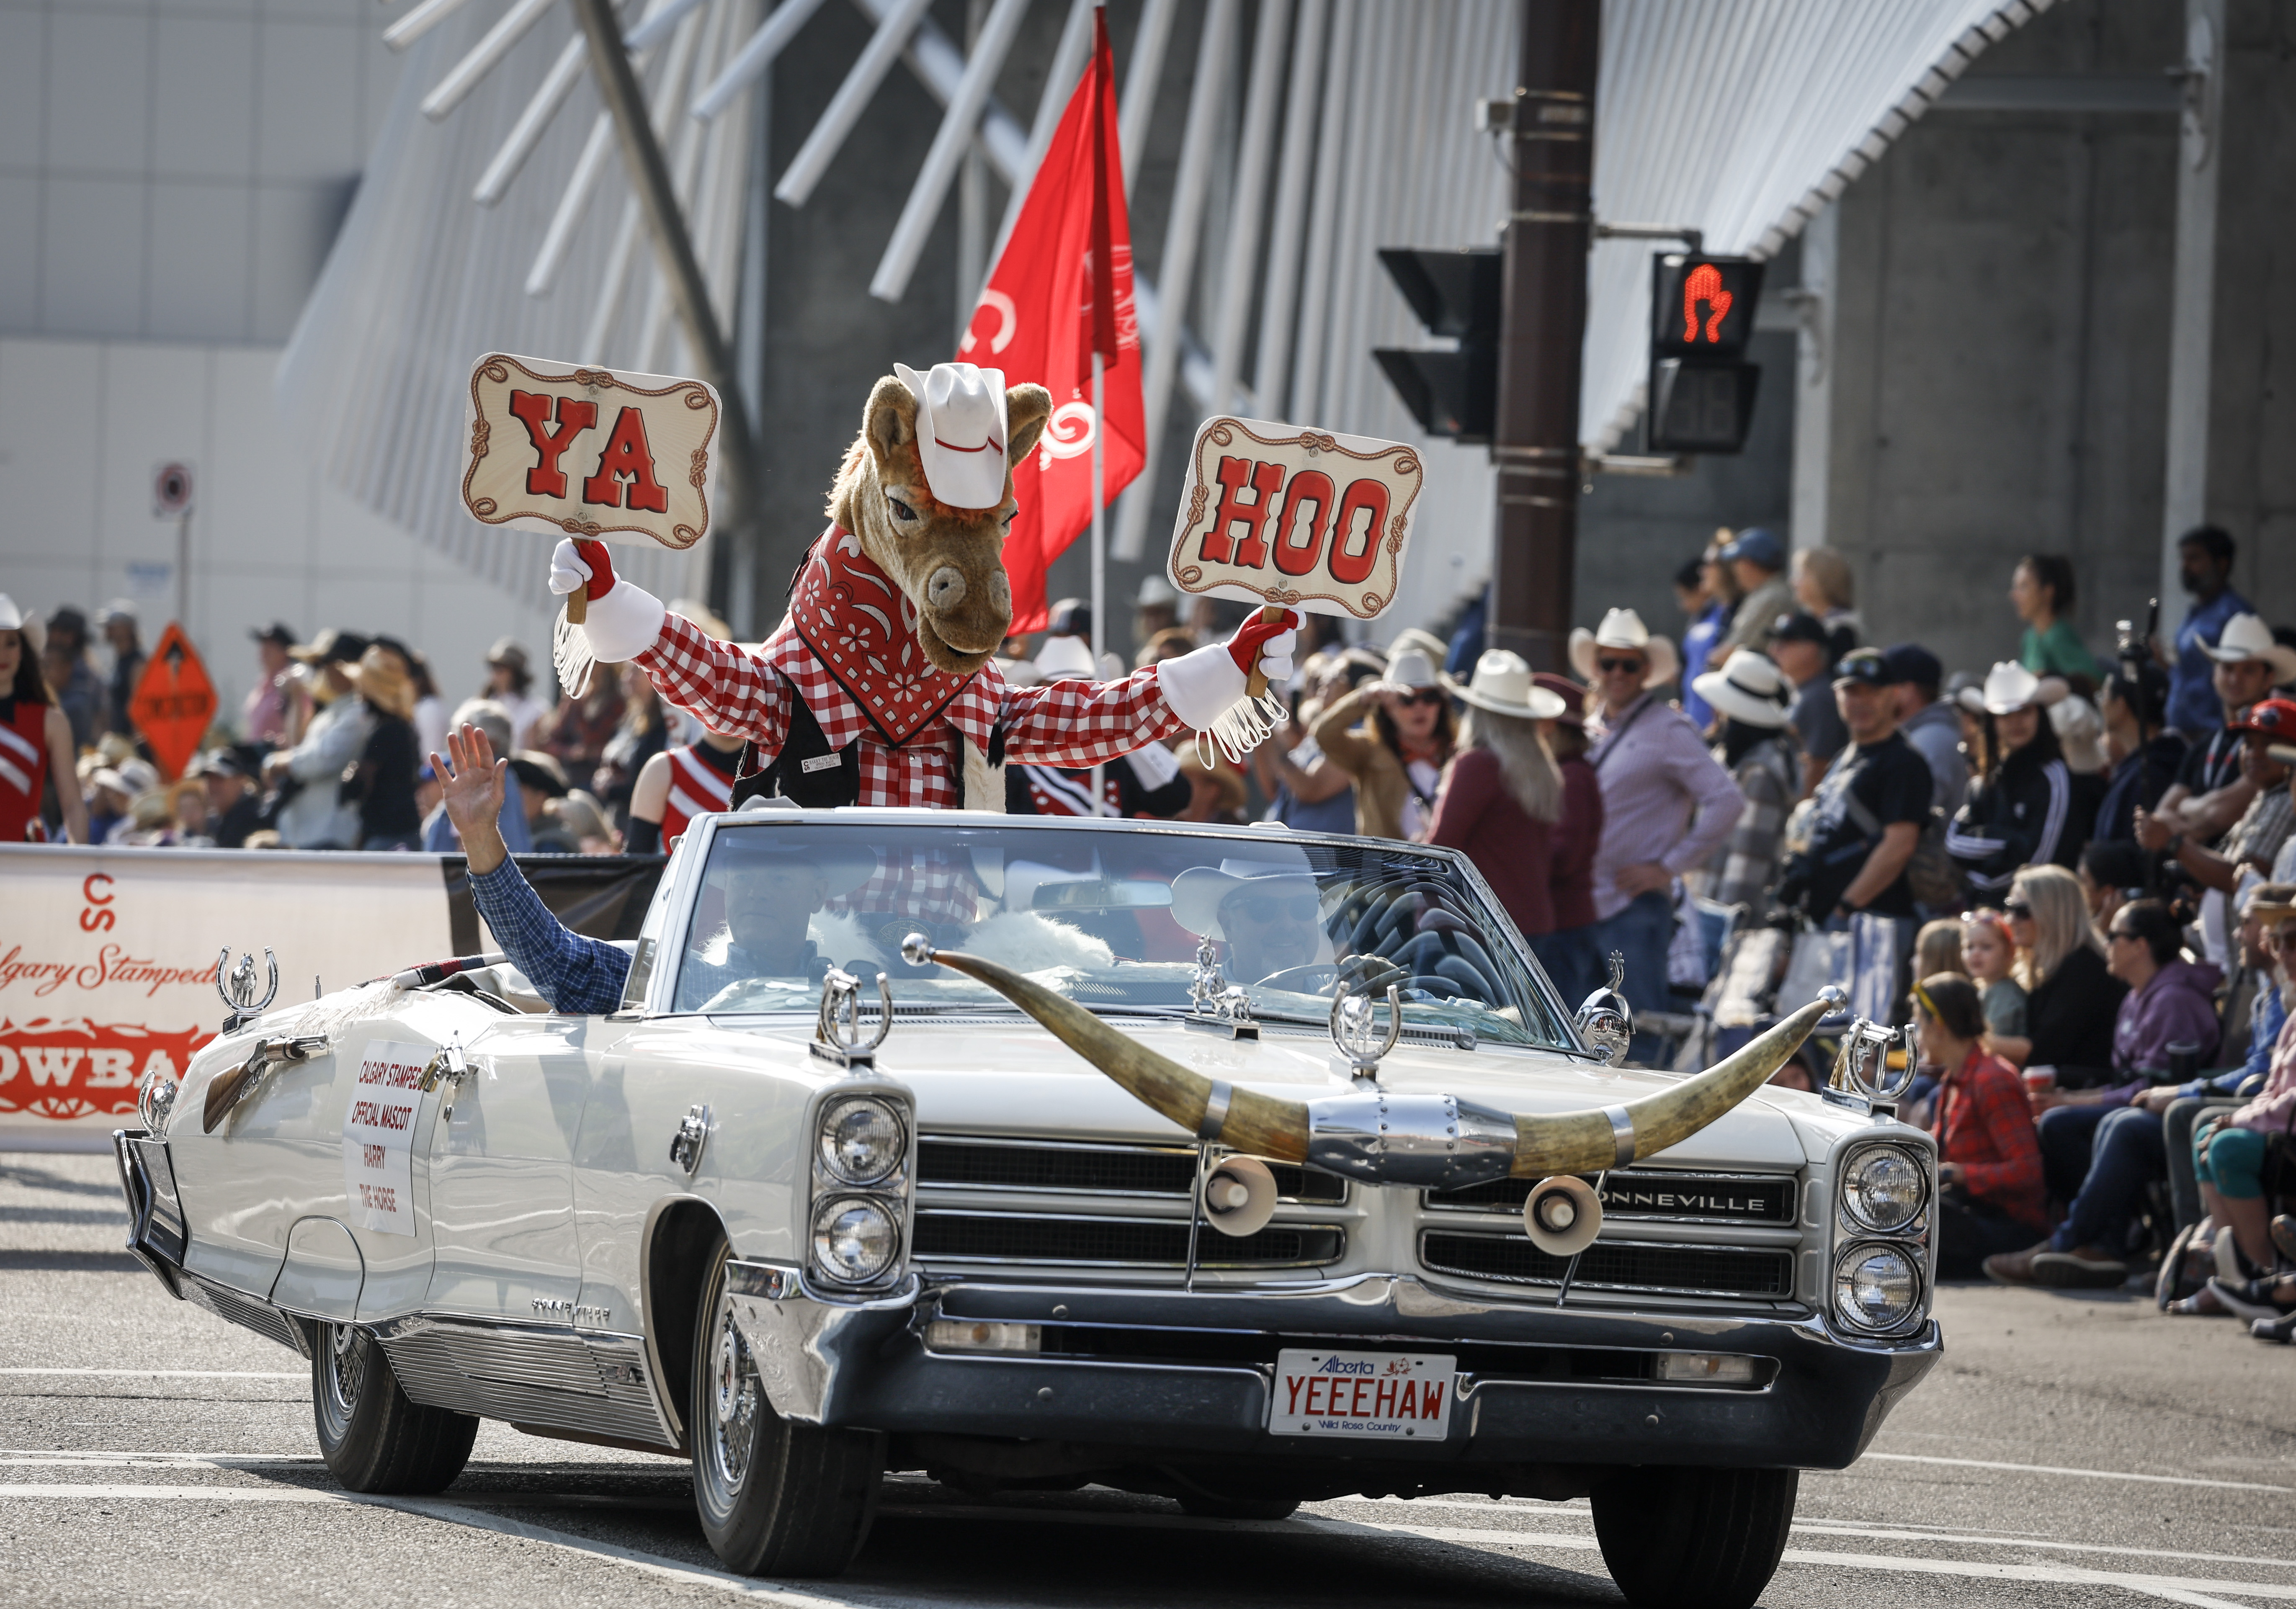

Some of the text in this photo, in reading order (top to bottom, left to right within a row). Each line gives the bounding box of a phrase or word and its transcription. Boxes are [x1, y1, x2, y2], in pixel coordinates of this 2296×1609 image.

[509, 389, 668, 513] YA
[1198, 456, 1390, 584] HOO
[0, 943, 230, 997] lgary Stamped
[359, 1060, 422, 1091] CALGARY STAMPED
[352, 1100, 412, 1131] OFFICIAL MASCOT
[364, 1143, 386, 1170] HARRY
[359, 1183, 397, 1213] THE HORSE
[1600, 1191, 1764, 1212] ONNEVILLE
[1317, 1354, 1374, 1375] Alberta
[1286, 1375, 1445, 1420] YEEEHAW
[1318, 1420, 1401, 1432] Wild Rose Country
